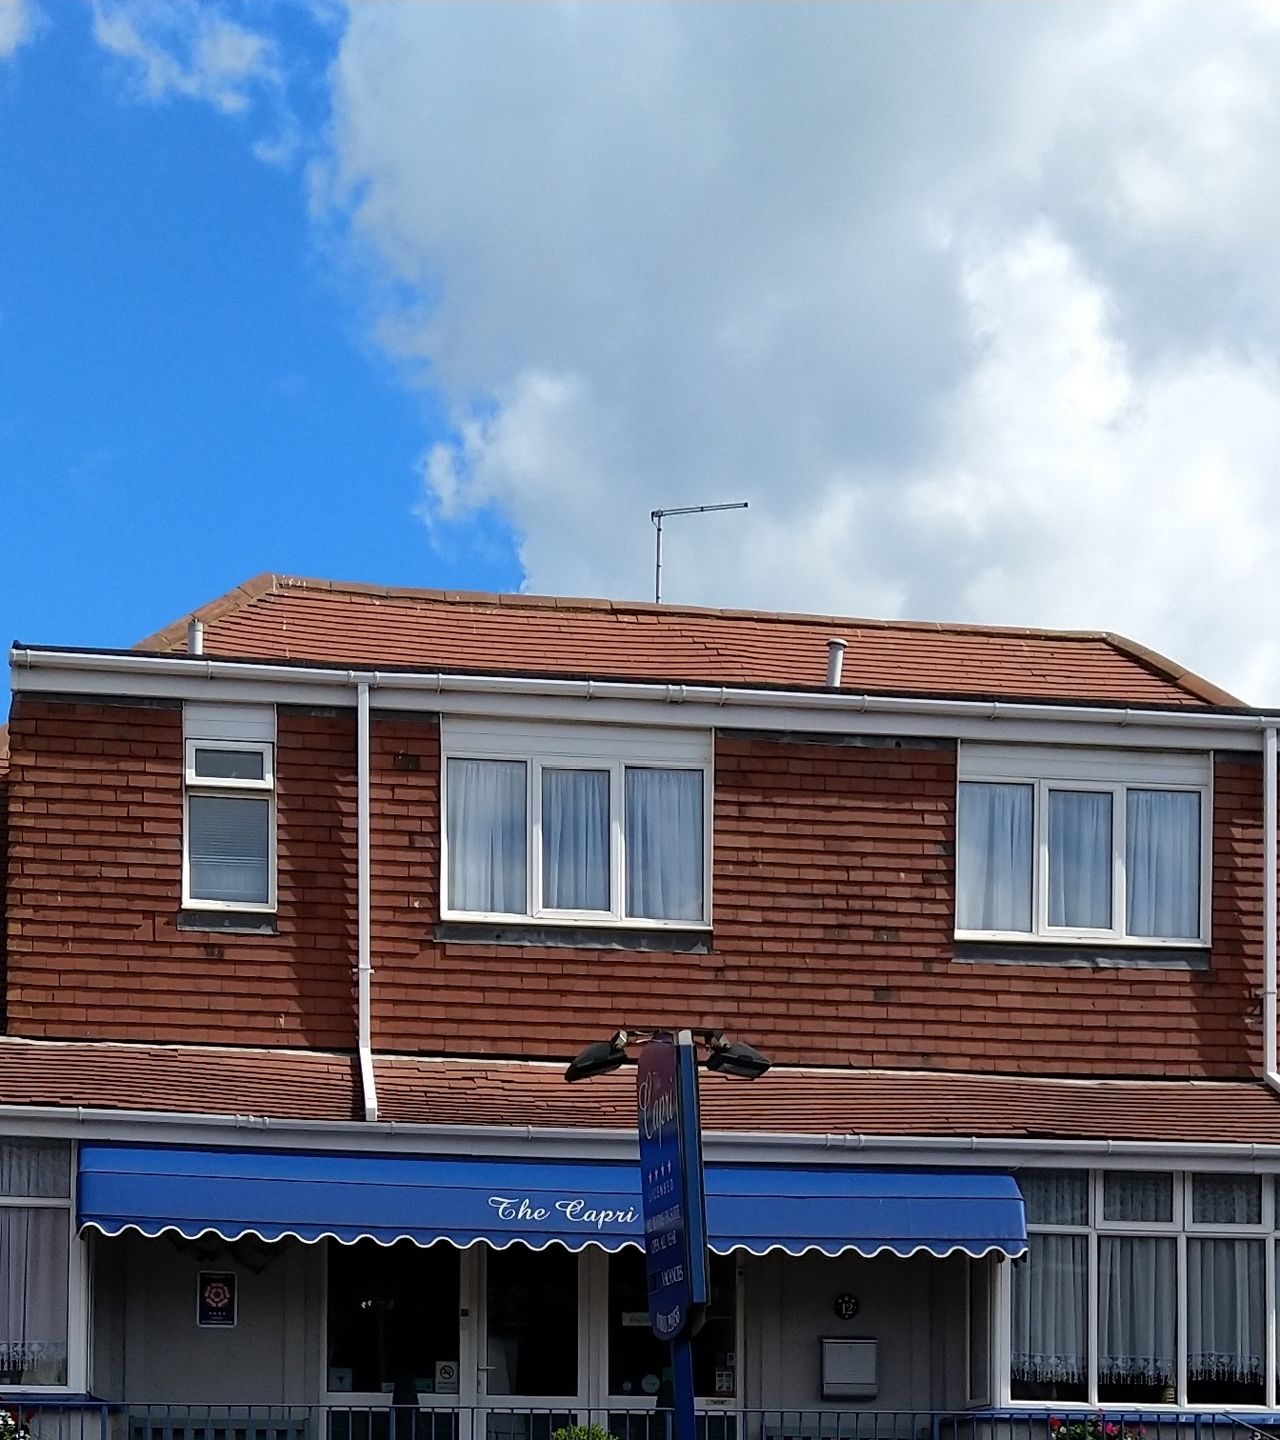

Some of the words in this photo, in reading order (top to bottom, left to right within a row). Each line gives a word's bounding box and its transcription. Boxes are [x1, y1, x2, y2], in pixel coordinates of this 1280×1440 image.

[488, 1196, 551, 1221] The
[555, 1199, 639, 1230] Capri
[842, 1302, 854, 1315] 12
